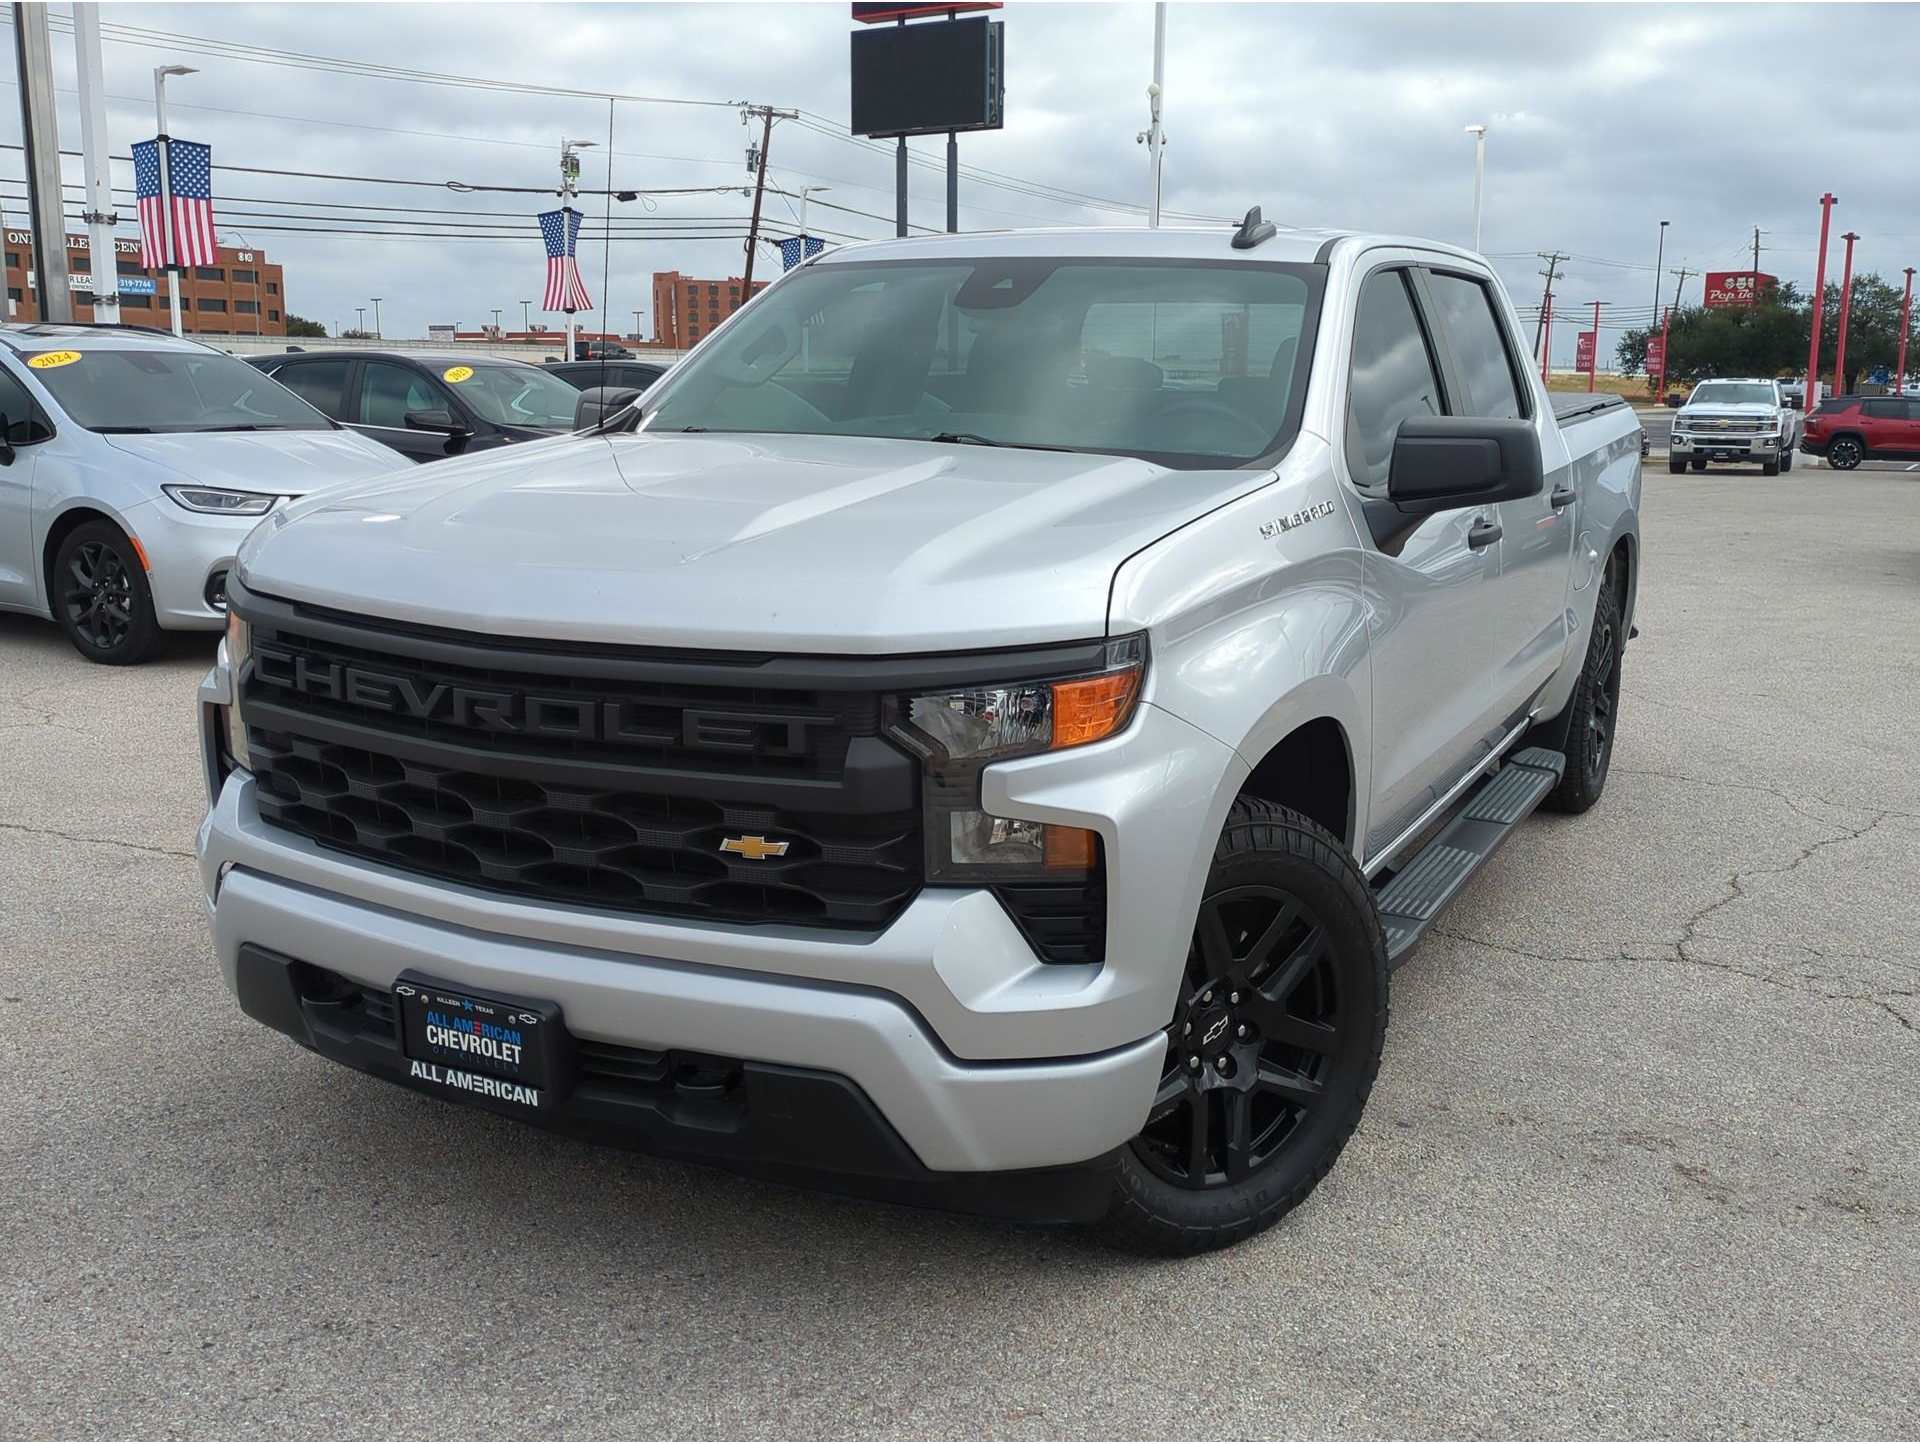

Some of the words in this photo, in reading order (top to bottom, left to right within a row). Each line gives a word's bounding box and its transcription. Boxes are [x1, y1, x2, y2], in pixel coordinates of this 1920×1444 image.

[115, 241, 141, 253] CEN
[253, 646, 843, 755] CHEVROLET
[474, 1004, 495, 1015] TEXAS
[426, 1025, 522, 1064] CHEVROLET
[427, 1011, 451, 1029] ALL
[453, 1018, 522, 1045] AMERICAN
[411, 1060, 442, 1083] ALL
[445, 1069, 539, 1107] AMERICAN
